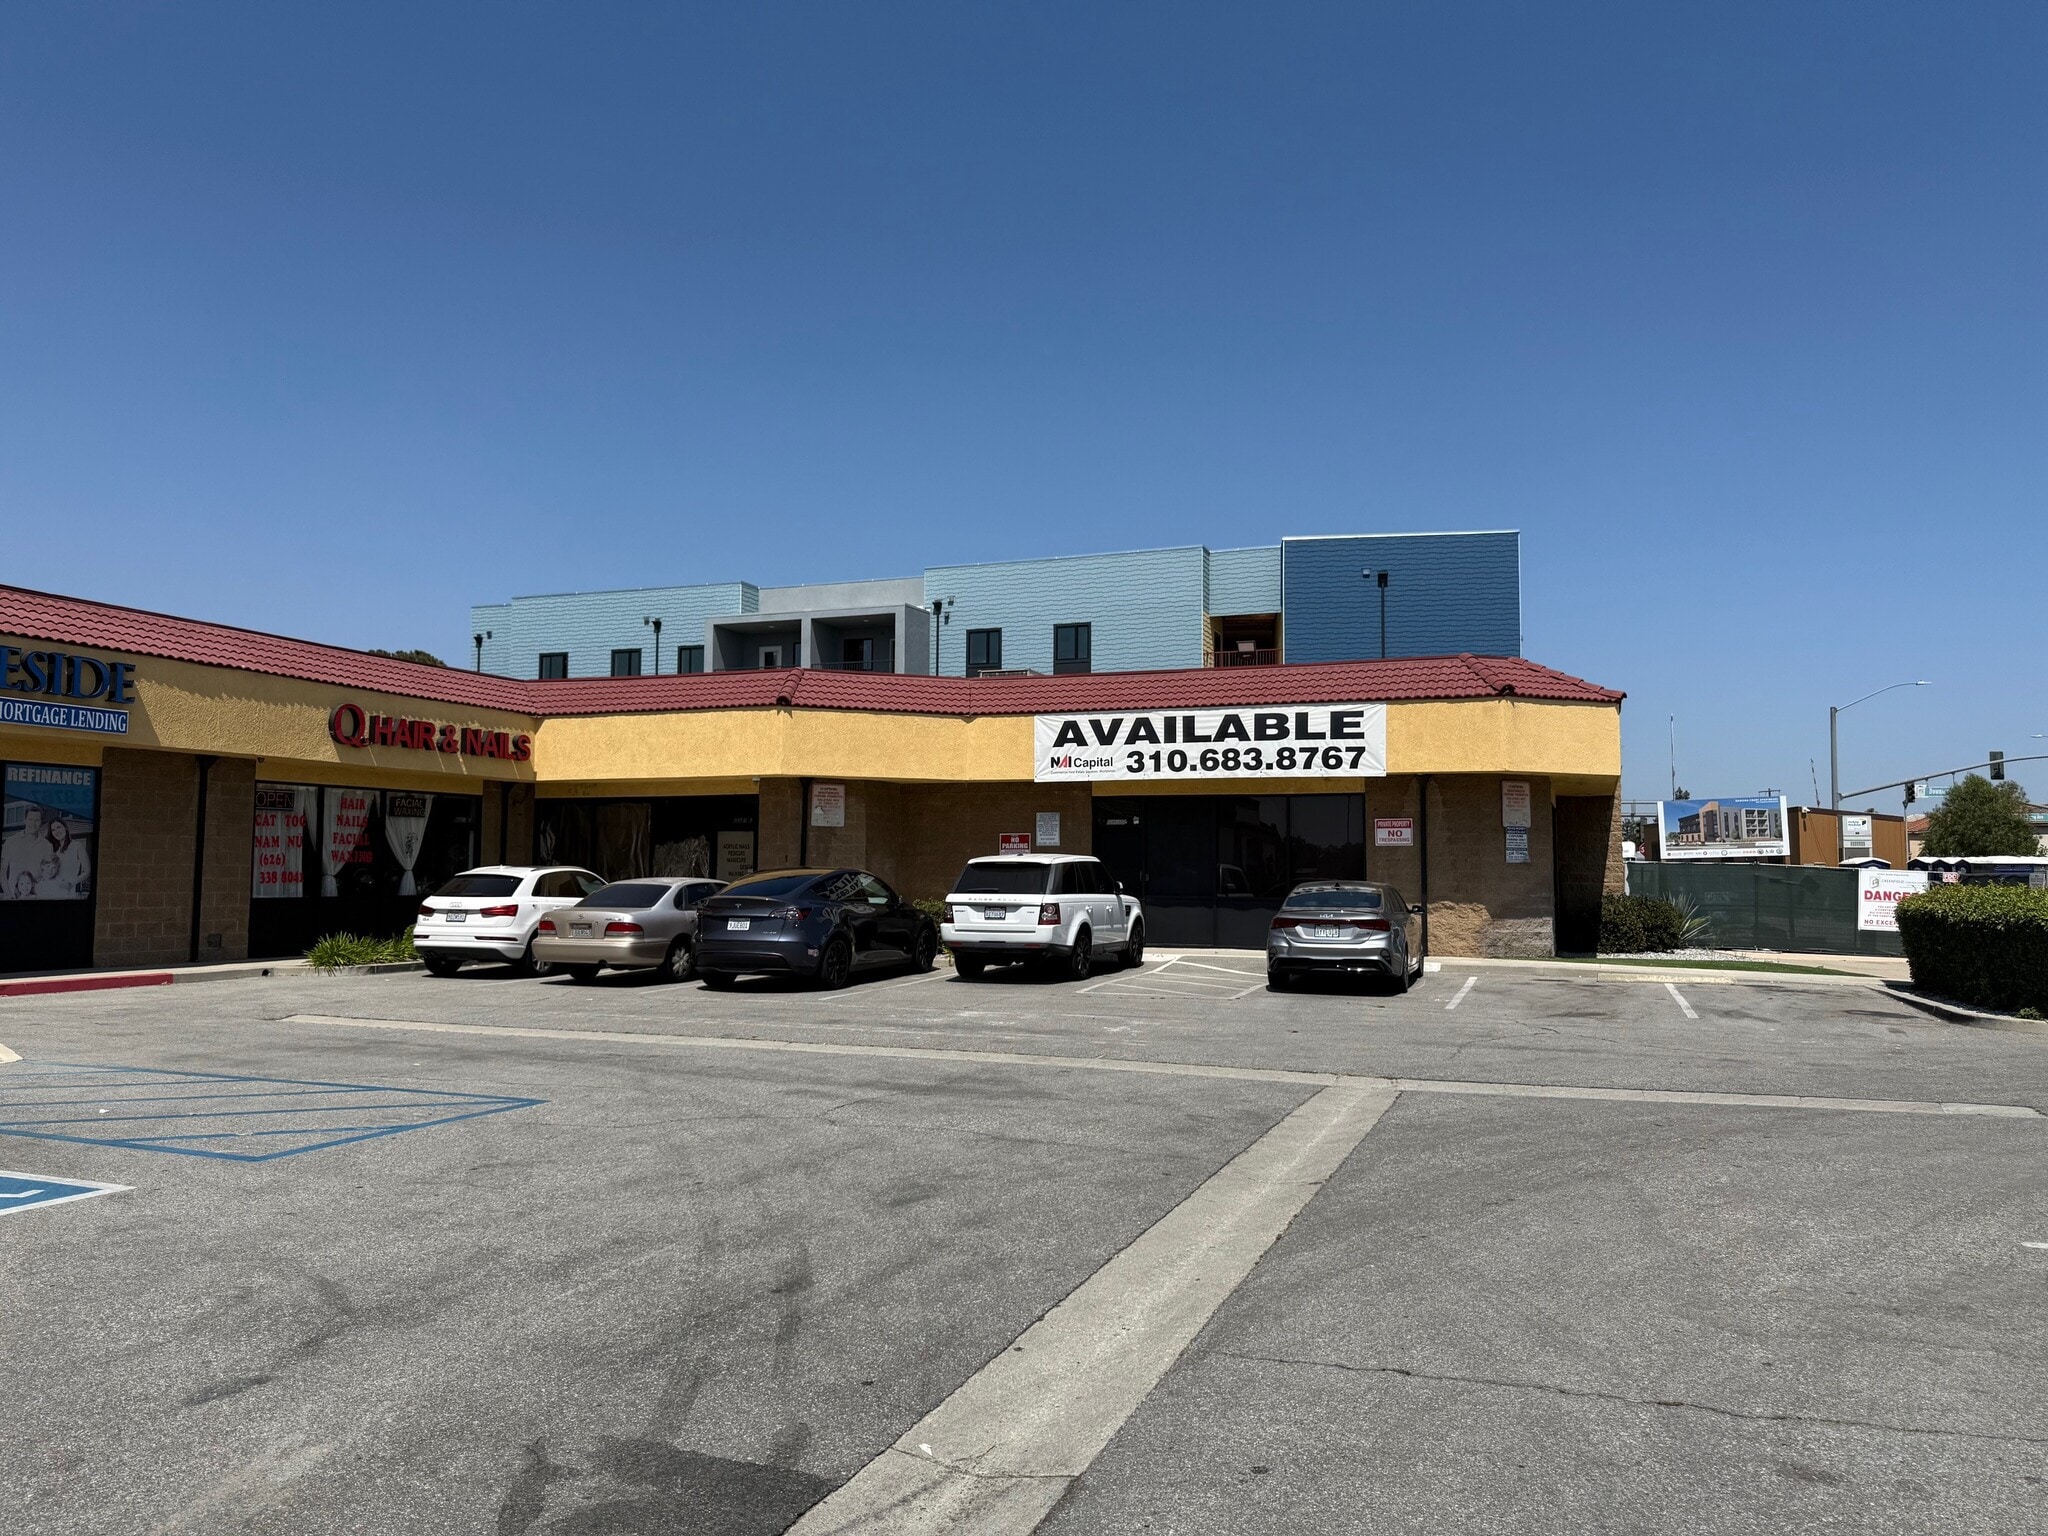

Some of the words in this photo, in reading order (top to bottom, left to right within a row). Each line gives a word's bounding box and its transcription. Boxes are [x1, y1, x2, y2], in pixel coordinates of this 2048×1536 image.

[70, 709, 127, 732] LENDING
[330, 703, 369, 748] Q
[369, 715, 436, 751] HAIR
[438, 725, 460, 753] &
[461, 727, 532, 761] NAILS
[1052, 710, 1365, 748] AVAILABLE
[1050, 754, 1072, 768] NAI
[1073, 756, 1113, 770] Capital
[1126, 746, 1367, 773] 310.683.8767
[7, 767, 91, 785] REFINANCE
[256, 791, 294, 807] OPEN
[340, 797, 366, 810] HAIR
[395, 798, 423, 808] FACIAL
[394, 807, 426, 816] WAXING
[255, 814, 277, 827] CAT
[336, 815, 369, 828] NAILS
[255, 835, 280, 848] NAM
[332, 832, 371, 846] FACIAL
[259, 852, 286, 866] (626)
[331, 850, 374, 864] WAXING
[259, 871, 278, 884] 338
